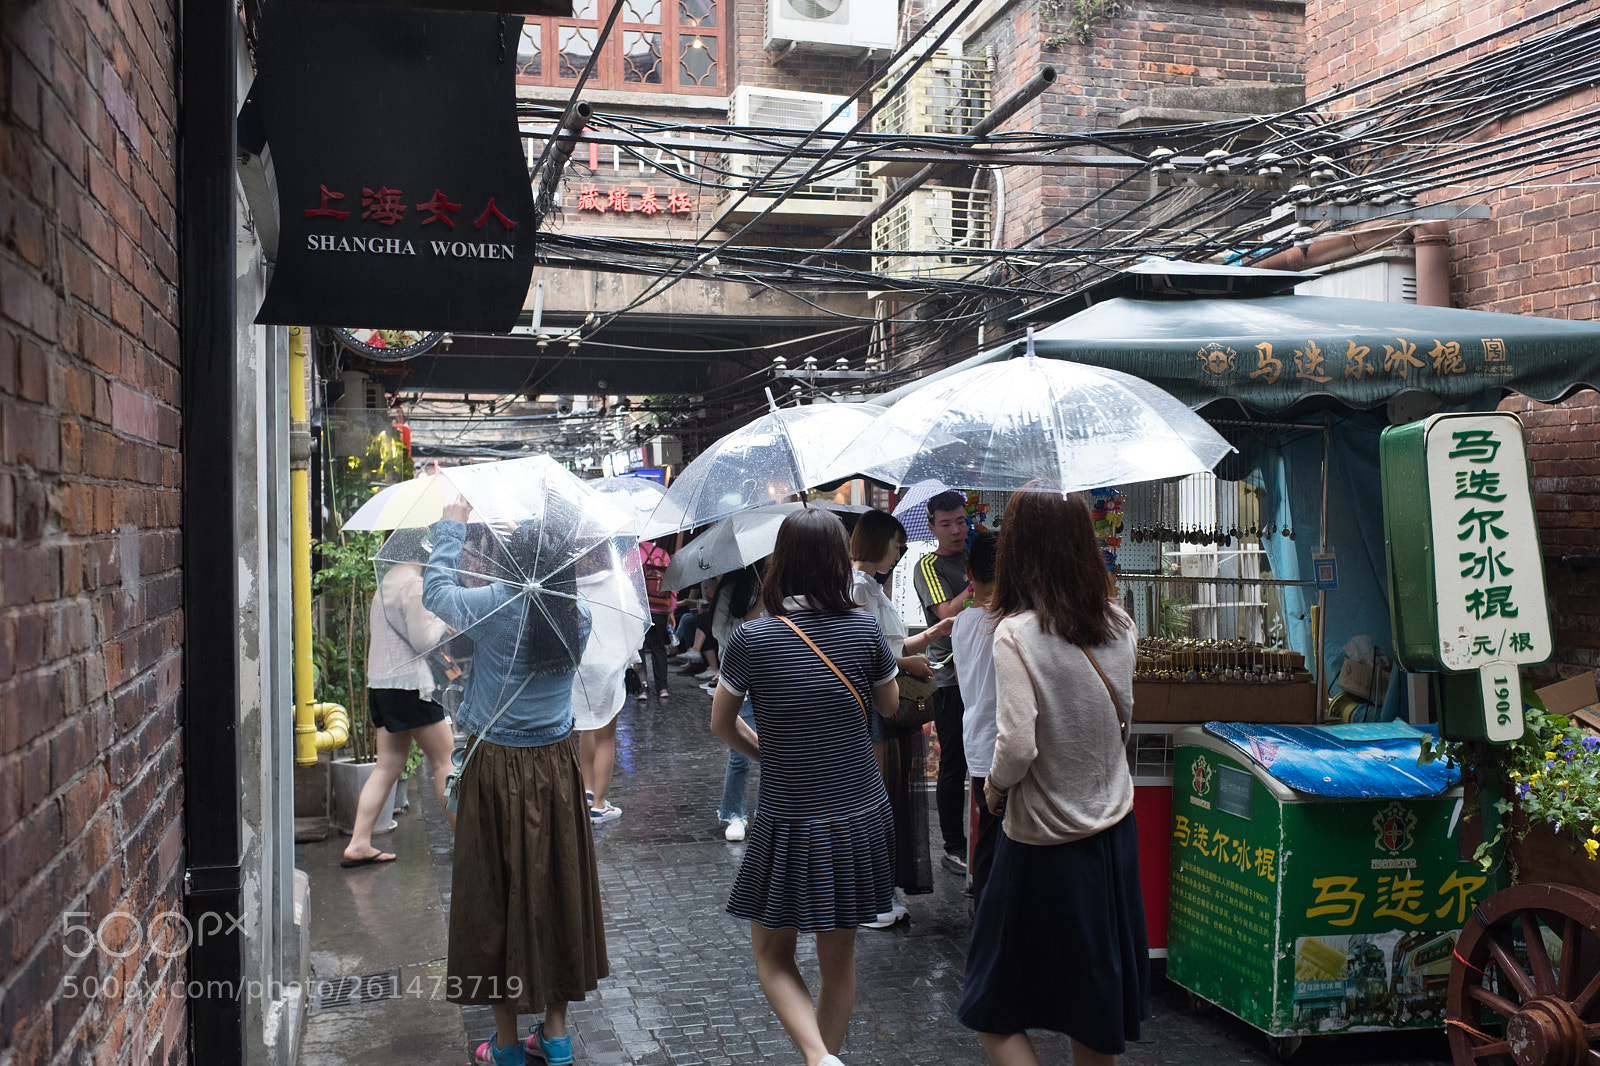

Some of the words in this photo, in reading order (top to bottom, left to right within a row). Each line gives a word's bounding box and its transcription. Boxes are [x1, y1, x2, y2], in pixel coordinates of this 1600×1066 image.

[304, 183, 519, 229] 上海女人
[307, 234, 417, 255] SHANGHA
[430, 240, 516, 260] WOMEN
[1249, 338, 1467, 384] 马迭尔冰棍
[1448, 430, 1519, 621] 马迭尔冰棍
[1493, 675, 1513, 726] 1906
[1172, 814, 1277, 883] 马迭尔冰棍
[1306, 870, 1488, 927] 马迭尔
